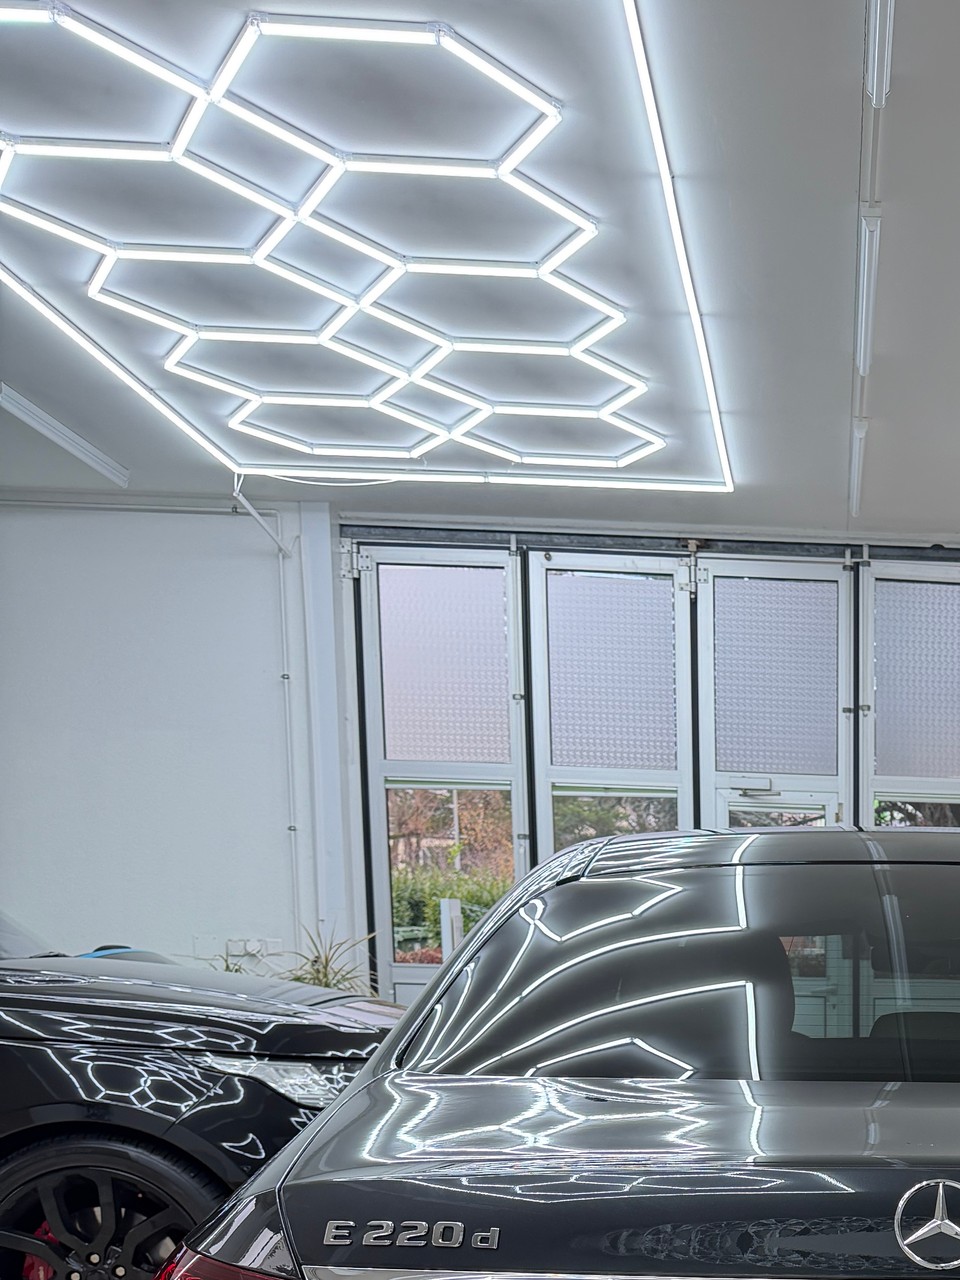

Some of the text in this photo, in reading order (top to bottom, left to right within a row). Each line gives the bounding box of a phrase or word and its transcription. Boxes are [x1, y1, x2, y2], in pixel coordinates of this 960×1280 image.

[323, 1220, 500, 1250] E 220 d
